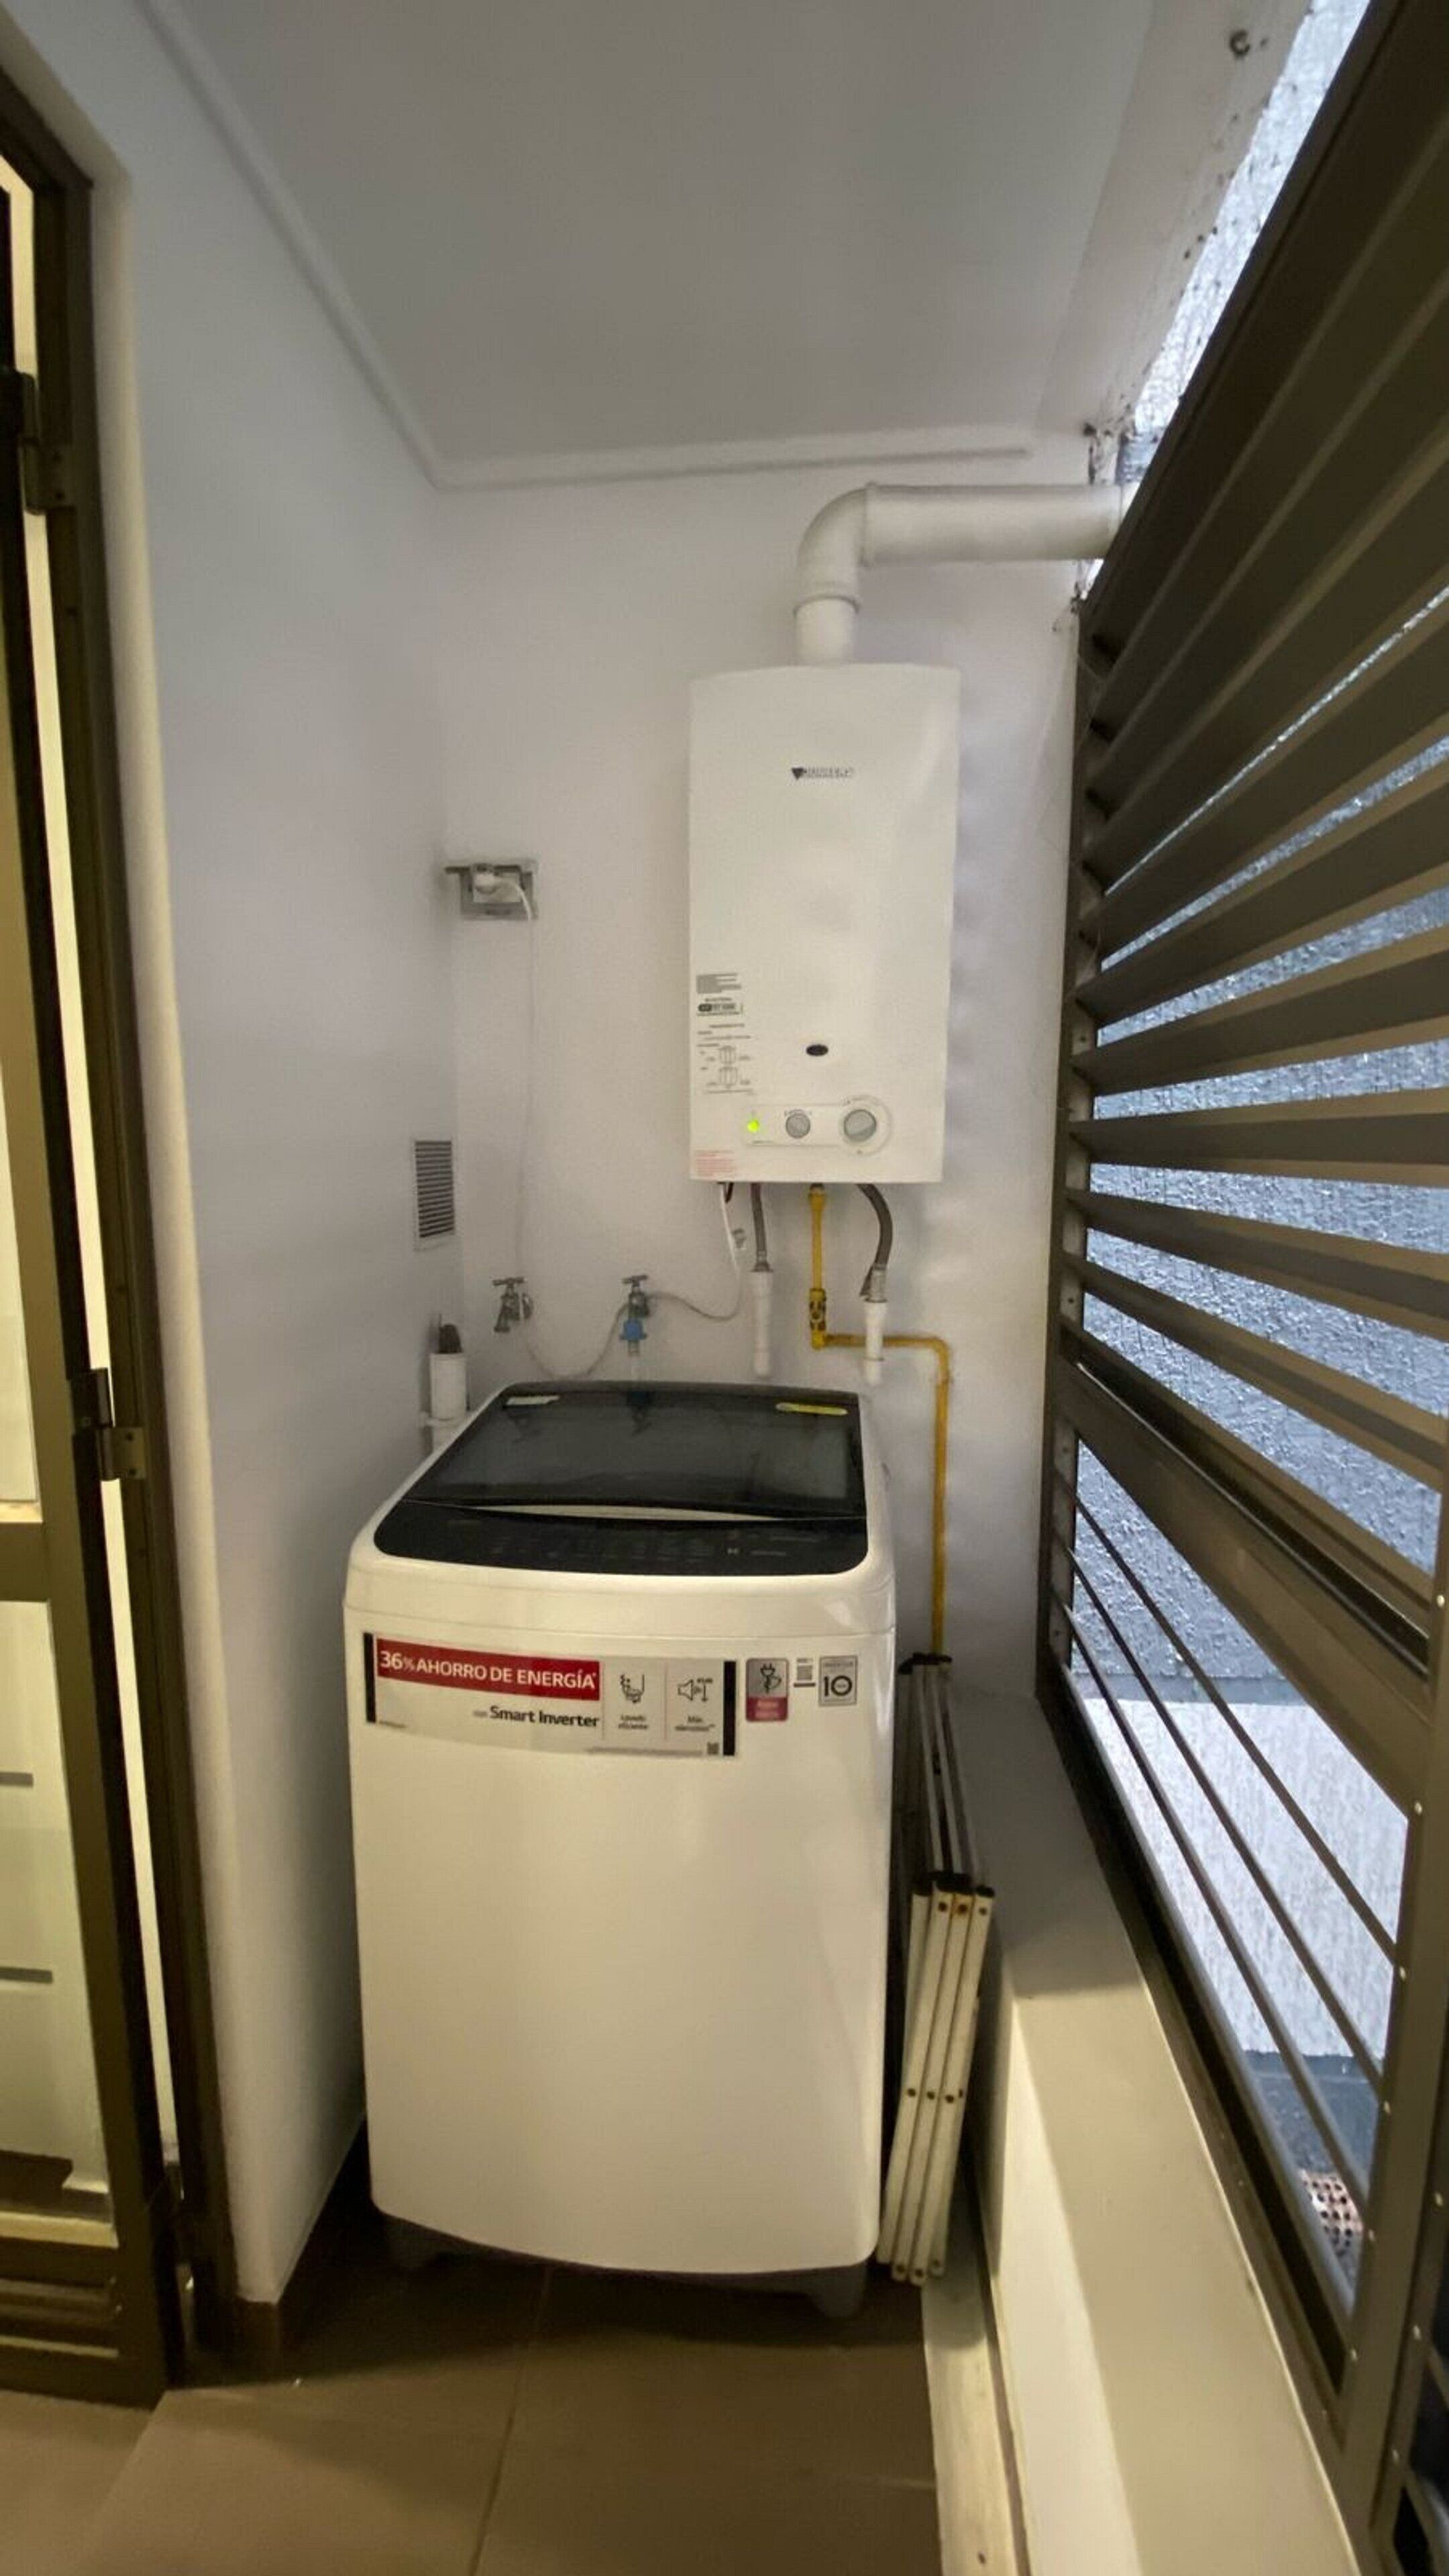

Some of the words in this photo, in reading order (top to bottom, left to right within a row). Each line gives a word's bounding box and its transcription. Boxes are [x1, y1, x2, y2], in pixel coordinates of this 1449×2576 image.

[380, 1650, 415, 1671] 36%
[416, 1657, 486, 1680] AHORRO
[490, 1666, 513, 1683] DE
[489, 1705, 535, 1723] Smart
[539, 1710, 600, 1727] Inverter
